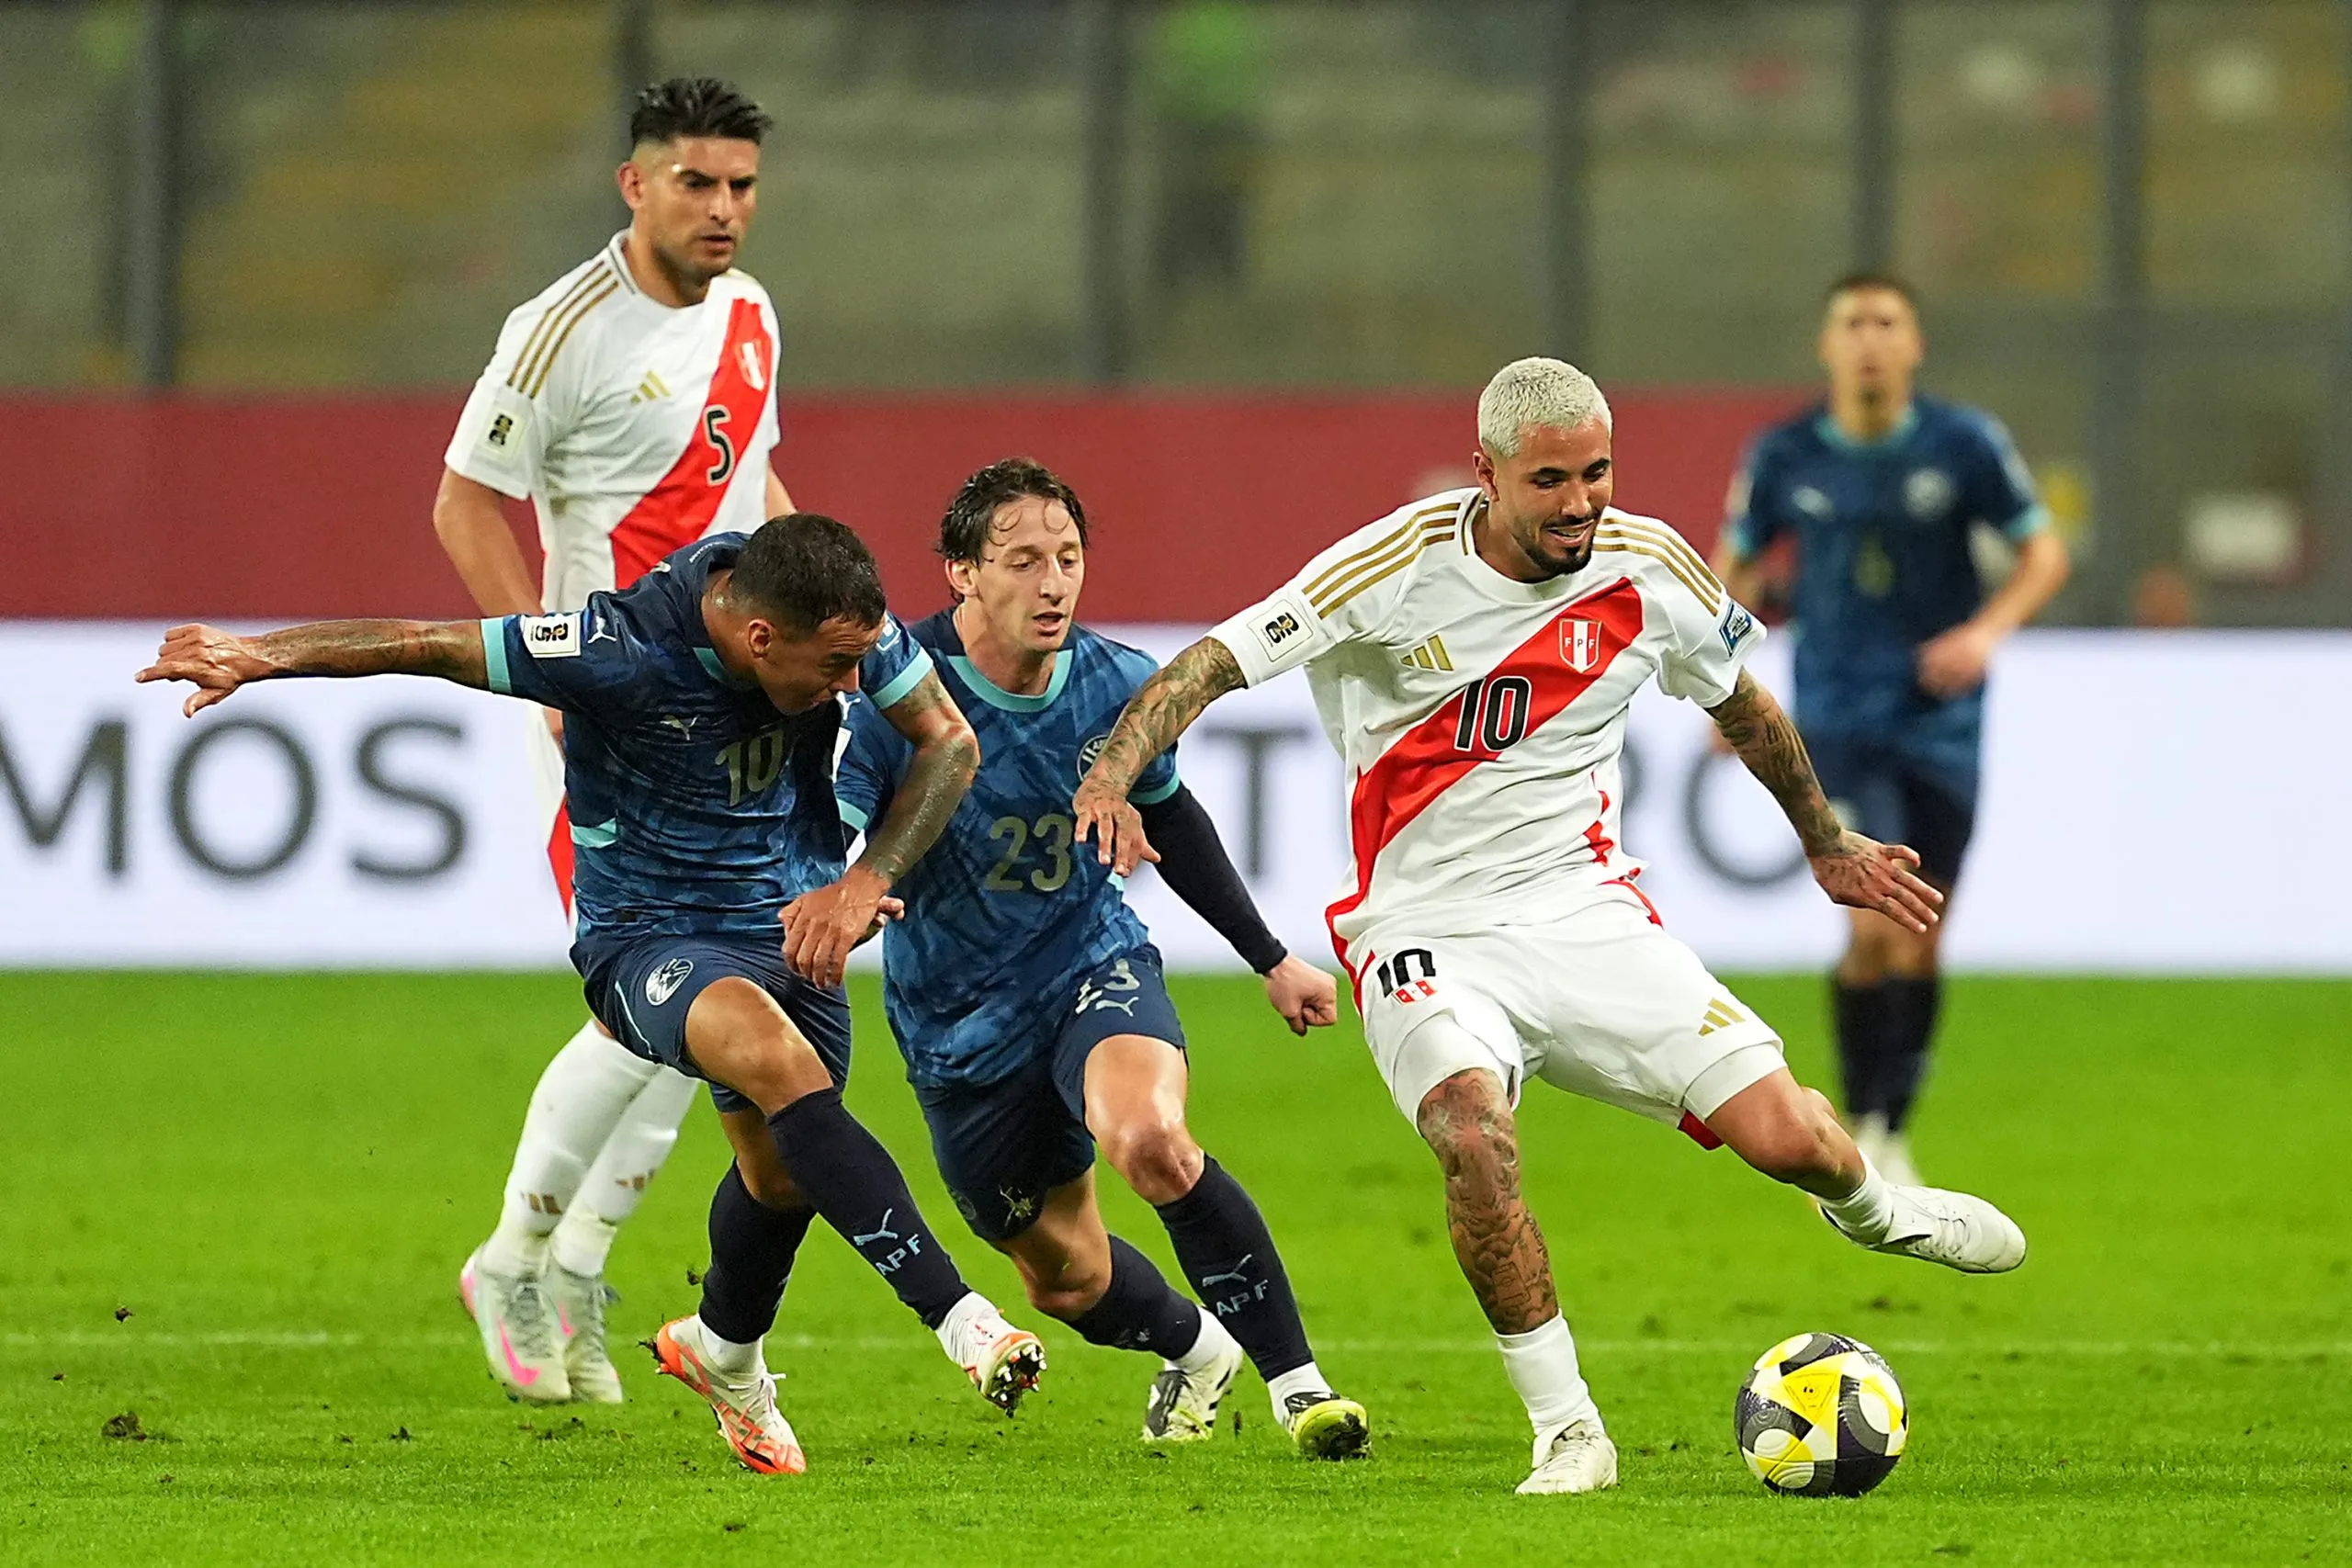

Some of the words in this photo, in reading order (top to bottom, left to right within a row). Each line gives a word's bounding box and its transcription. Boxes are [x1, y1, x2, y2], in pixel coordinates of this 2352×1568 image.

[702, 404, 736, 487] 5
[1453, 675, 1532, 752] 10
[715, 728, 785, 808] 10
[985, 813, 1074, 892] 23
[876, 1234, 921, 1276] APF
[1216, 1279, 1269, 1317] APF
